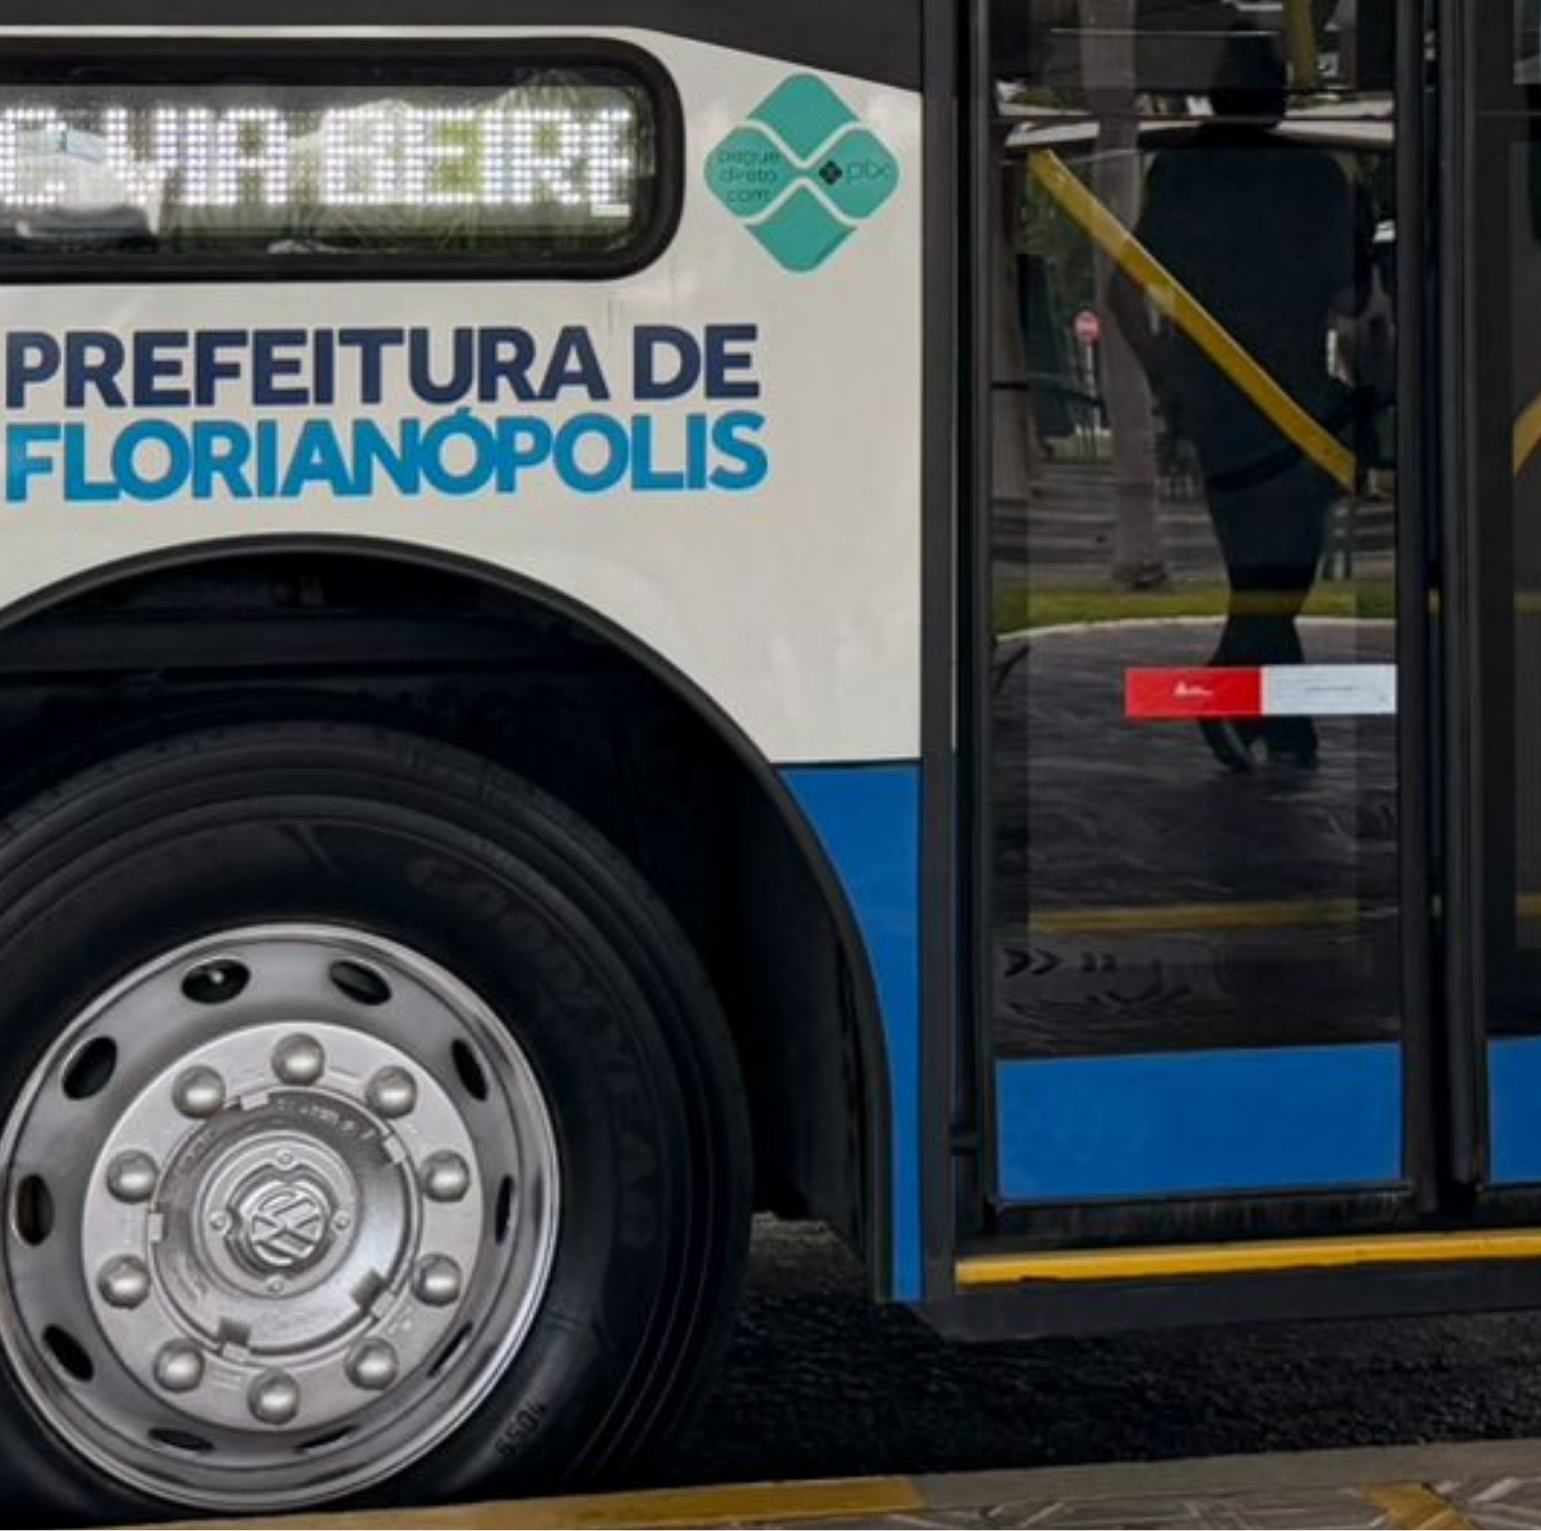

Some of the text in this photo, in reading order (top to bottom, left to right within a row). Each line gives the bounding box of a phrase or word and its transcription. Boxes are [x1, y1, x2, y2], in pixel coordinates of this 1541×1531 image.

[105, 107, 288, 206] VIA
[717, 150, 781, 168] pague
[846, 161, 890, 186] pix
[4, 325, 761, 409] PREFEITURA DE
[4, 407, 770, 503] FLORIANÓPOLIS
